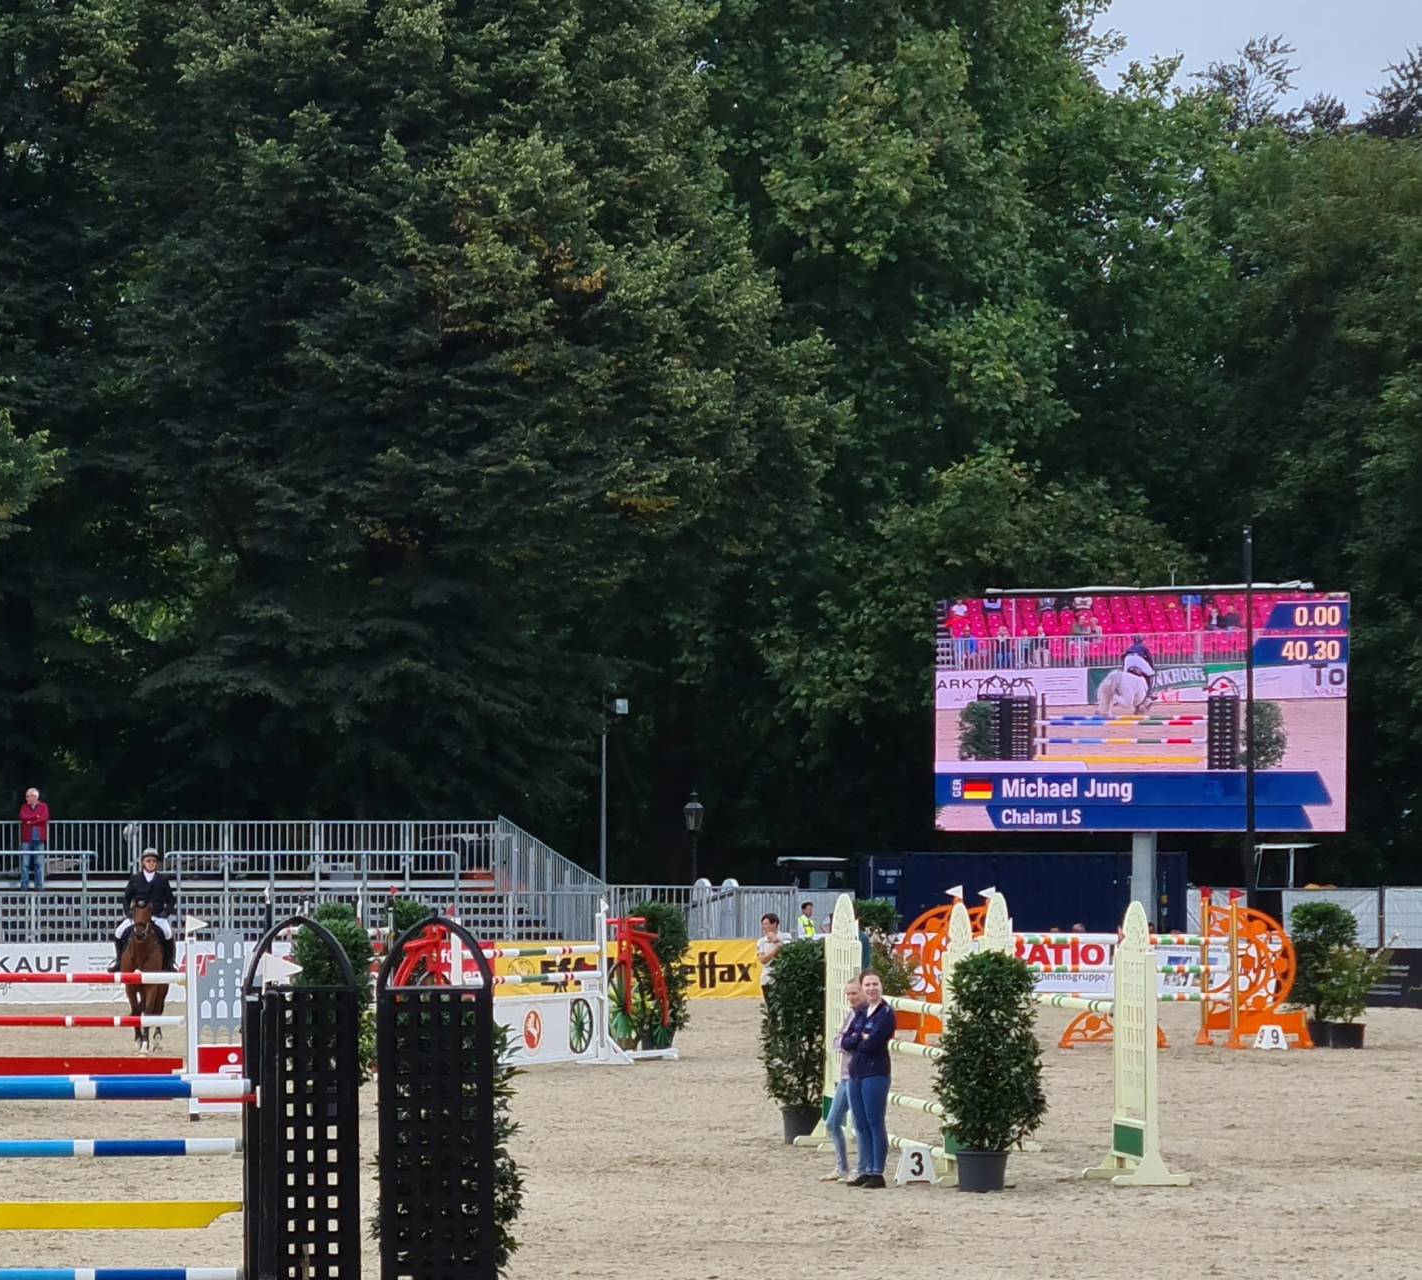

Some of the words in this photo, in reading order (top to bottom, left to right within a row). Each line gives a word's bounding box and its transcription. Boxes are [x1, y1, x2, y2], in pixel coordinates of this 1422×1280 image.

[1294, 606, 1341, 627] 0.00
[1281, 640, 1341, 661] 40.30
[952, 778, 962, 798] GER
[1001, 778, 1078, 798] Michael
[1084, 778, 1133, 802] Jung
[1001, 808, 1058, 824] Chalam
[1062, 809, 1081, 824] LS
[1271, 1029, 1280, 1044] 9
[910, 1151, 924, 1177] 3
